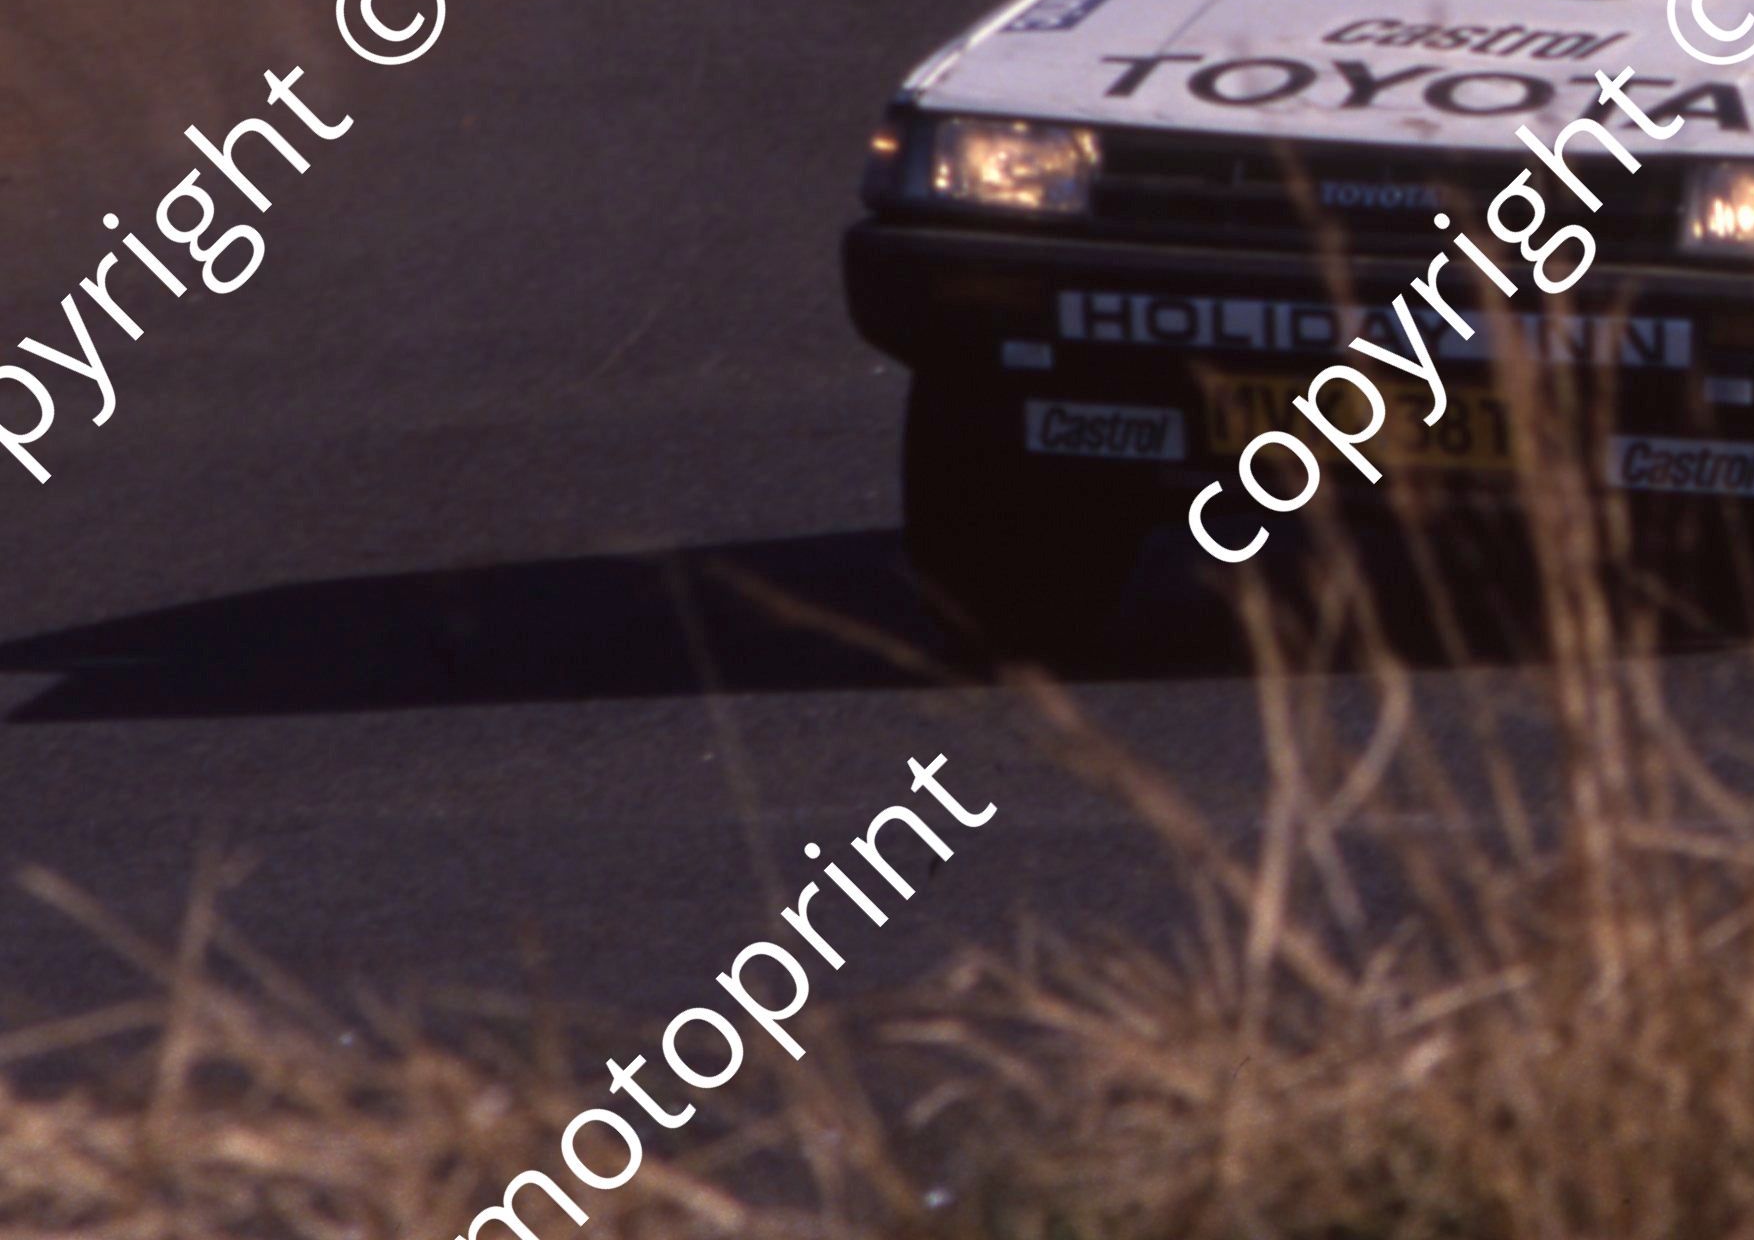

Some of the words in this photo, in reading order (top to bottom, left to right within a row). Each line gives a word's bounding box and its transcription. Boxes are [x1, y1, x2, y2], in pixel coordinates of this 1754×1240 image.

[1320, 16, 1636, 62] Castrol
[1101, 53, 1753, 135] TOYOTA
[1083, 294, 1456, 355] HOLIDAY
[1041, 408, 1172, 458] Castrol
